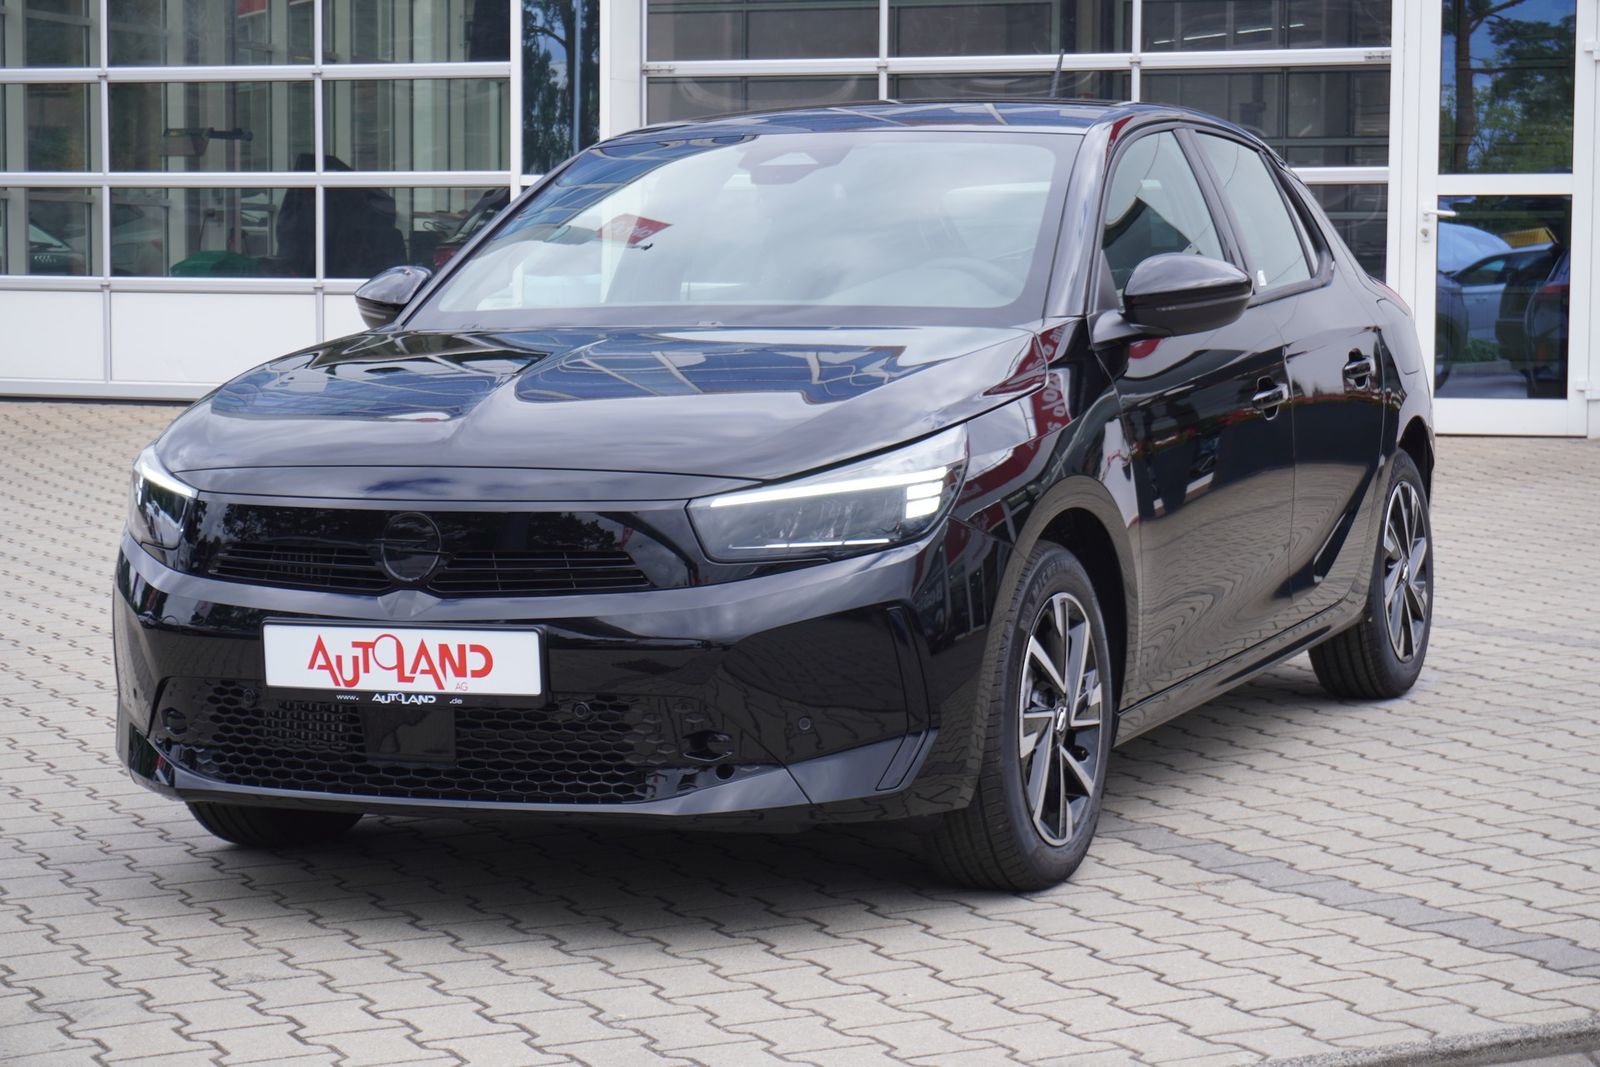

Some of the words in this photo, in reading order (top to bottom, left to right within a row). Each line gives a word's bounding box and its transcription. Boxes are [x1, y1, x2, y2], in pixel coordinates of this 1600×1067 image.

[307, 633, 494, 691] AUTOLAND
[455, 681, 469, 692] AG
[336, 693, 359, 701] www.
[371, 692, 437, 705] AUTOLAND
[449, 697, 463, 705] .de
